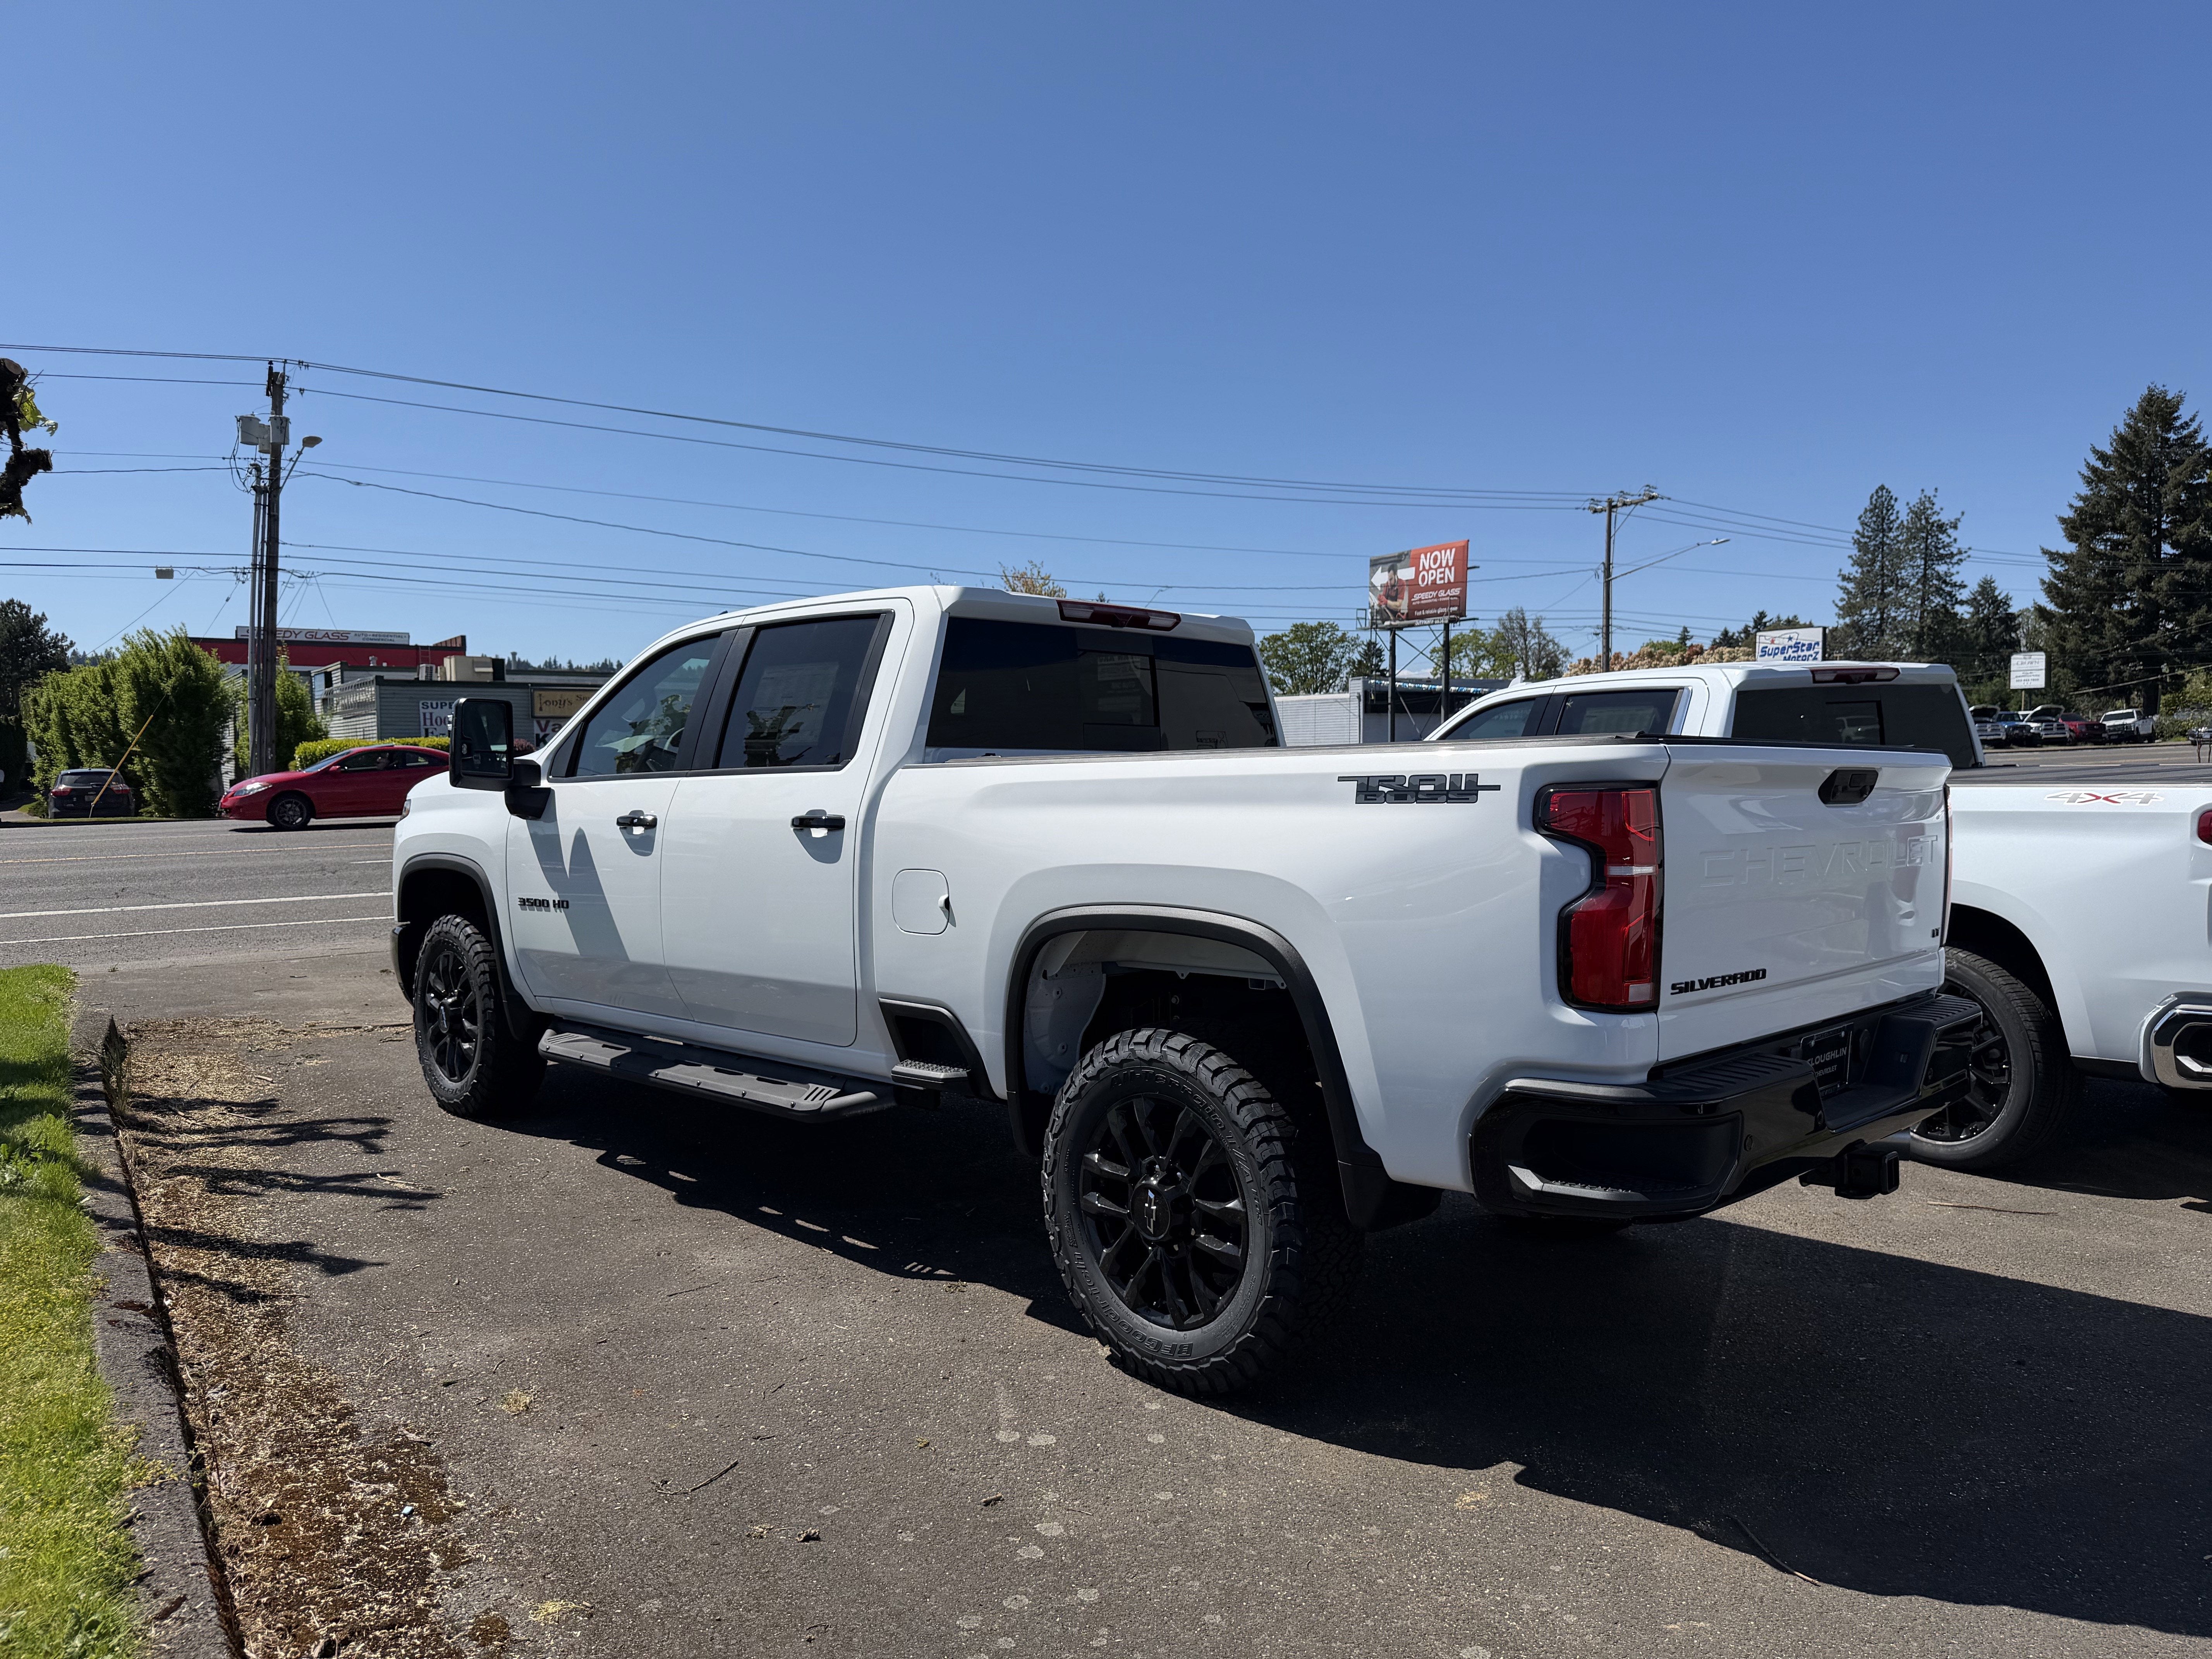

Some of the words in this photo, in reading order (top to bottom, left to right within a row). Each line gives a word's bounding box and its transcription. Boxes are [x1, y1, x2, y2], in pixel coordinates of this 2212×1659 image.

[1419, 548, 1455, 571] NOW
[1419, 566, 1455, 587] OPEN
[1411, 590, 1438, 601] SPEEDY
[1438, 588, 1461, 597] GLASS
[305, 631, 351, 641] GLASS
[1759, 641, 1820, 658] SuperStar
[1337, 773, 1501, 791] TRAIL
[1355, 790, 1479, 804] BOSS
[1698, 835, 1938, 888] CHEVROLET
[518, 897, 550, 908] 3500
[553, 900, 569, 909] HD
[1670, 968, 1767, 995] SILVERADO
[1074, 1252, 1194, 1357] BFGoodrich
